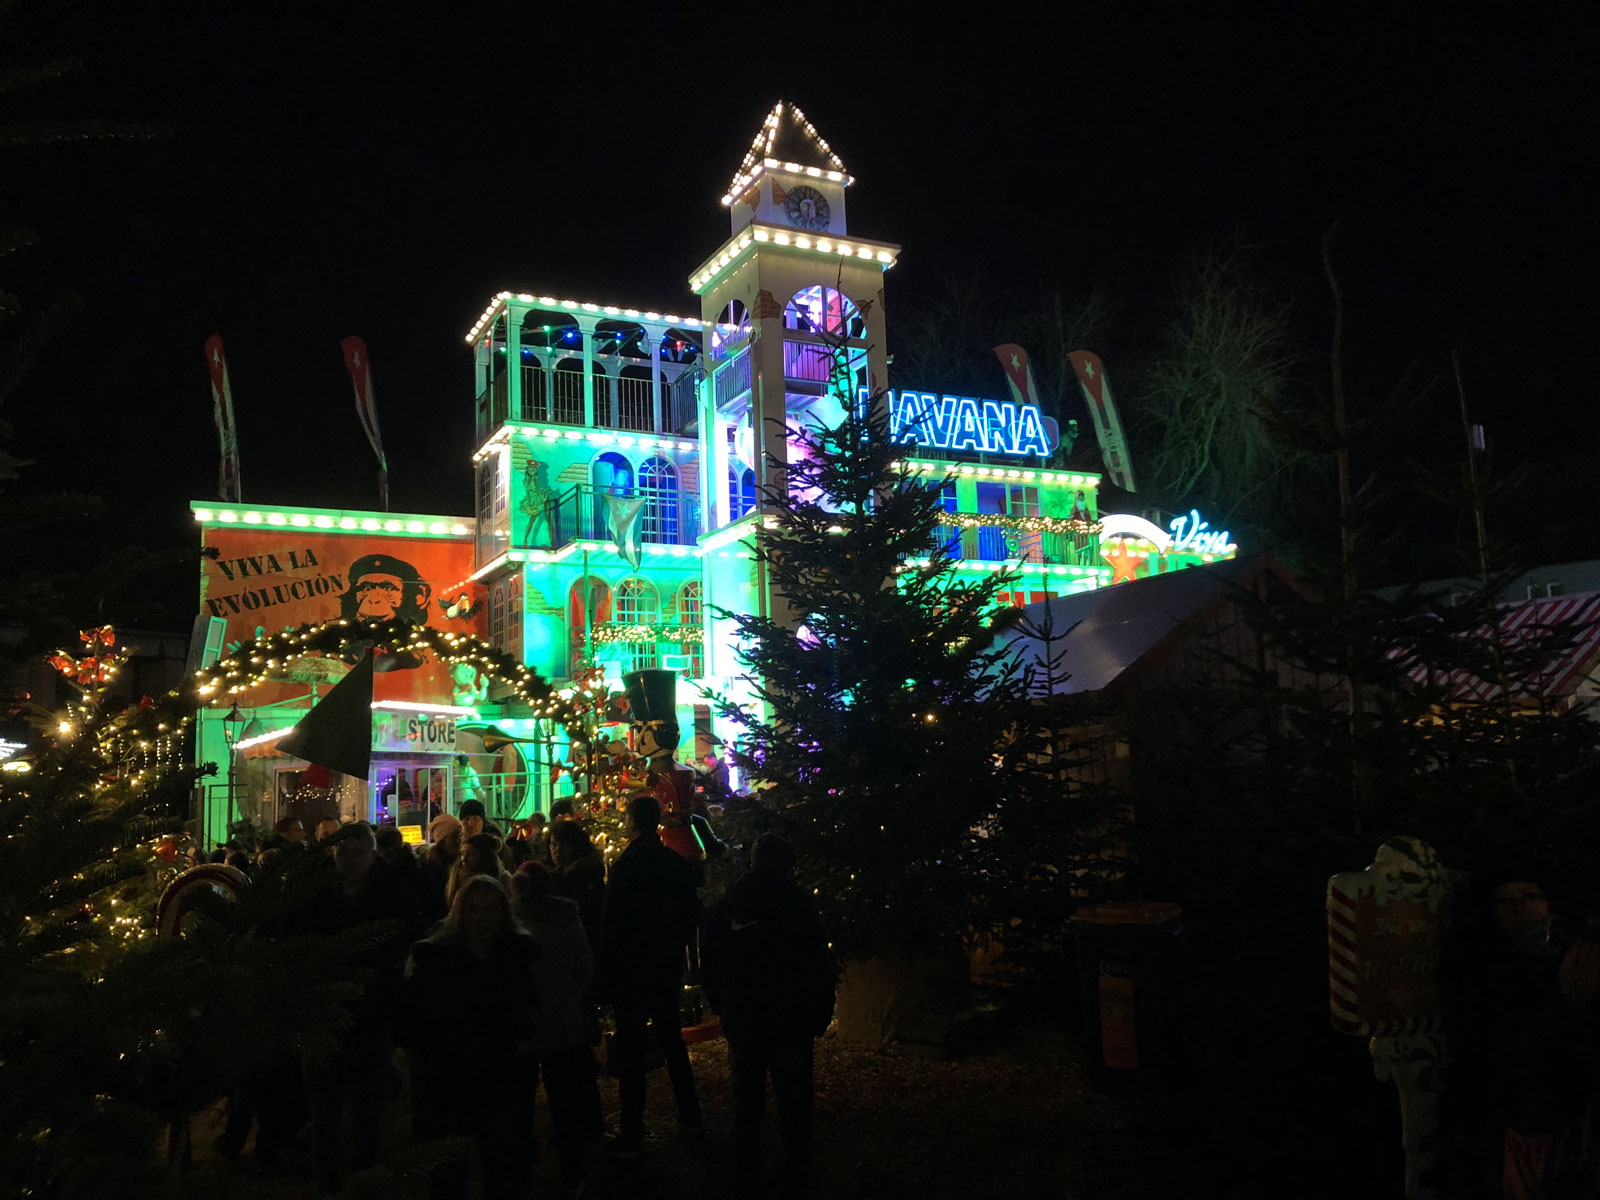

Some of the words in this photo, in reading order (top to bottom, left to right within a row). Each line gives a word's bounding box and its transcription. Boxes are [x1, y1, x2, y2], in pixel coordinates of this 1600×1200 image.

[1170, 509, 1231, 554] Viva
[216, 554, 283, 581] VIVA
[288, 549, 319, 570] LA
[408, 719, 456, 744] STORE
